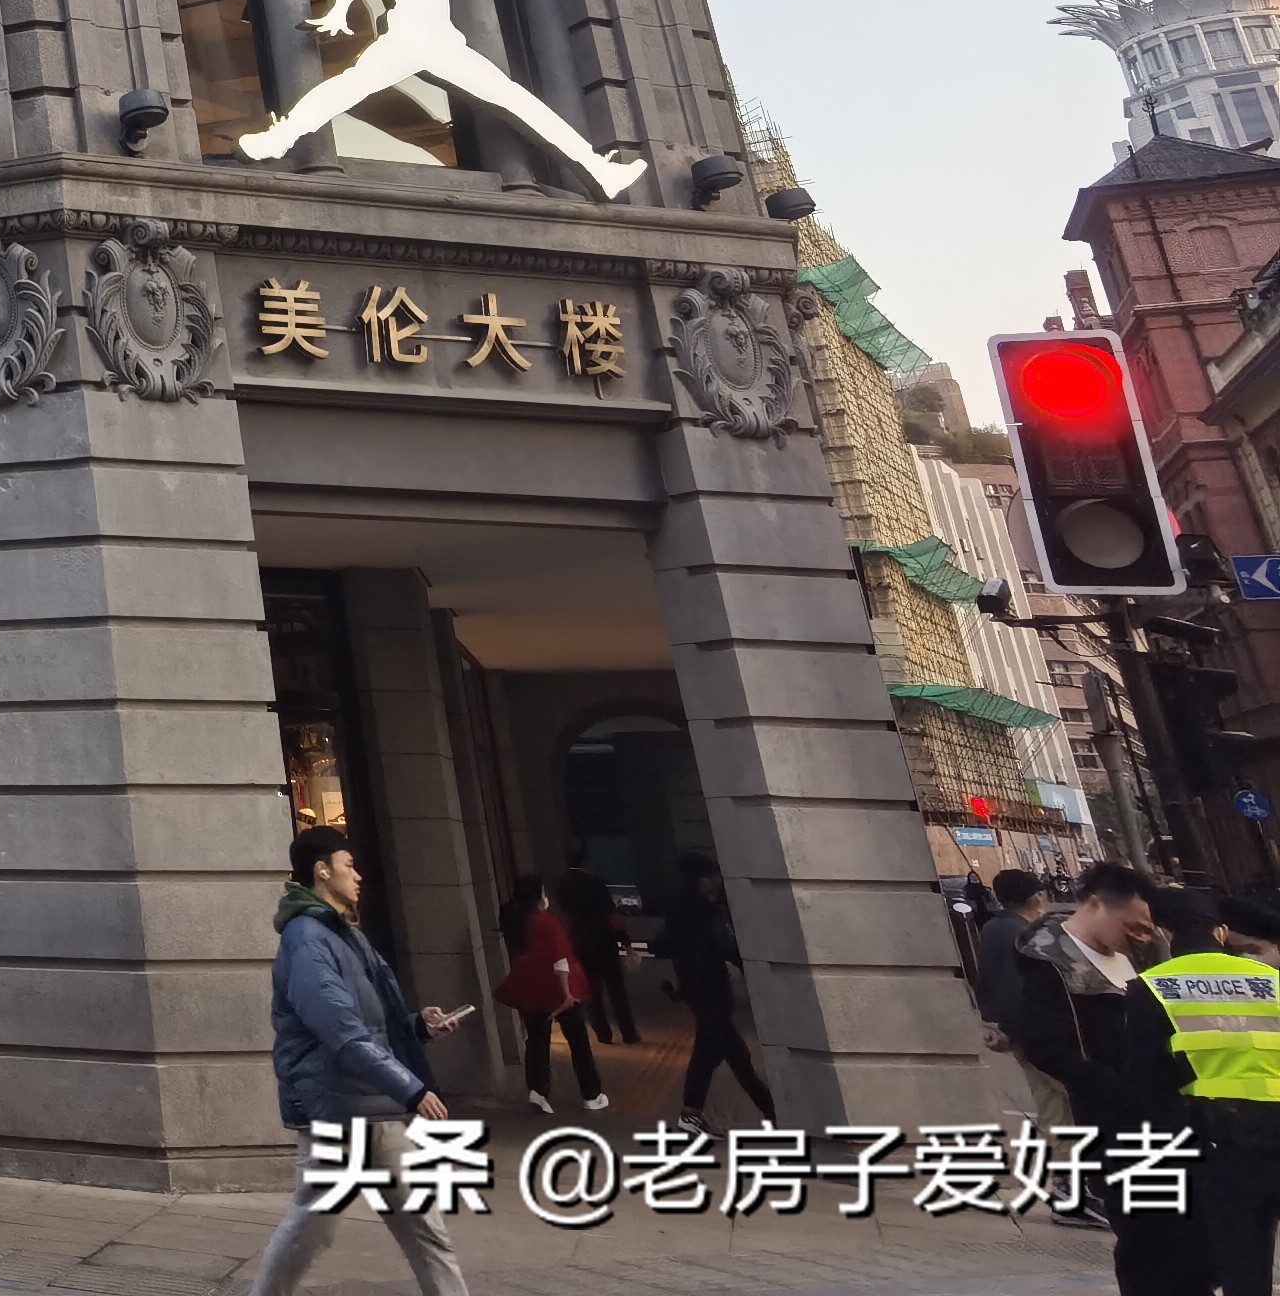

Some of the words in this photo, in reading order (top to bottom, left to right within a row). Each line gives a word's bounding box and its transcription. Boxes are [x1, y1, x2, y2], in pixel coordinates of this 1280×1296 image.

[256, 277, 627, 379] 美伦大楼
[1185, 979, 1246, 996] POLICE
